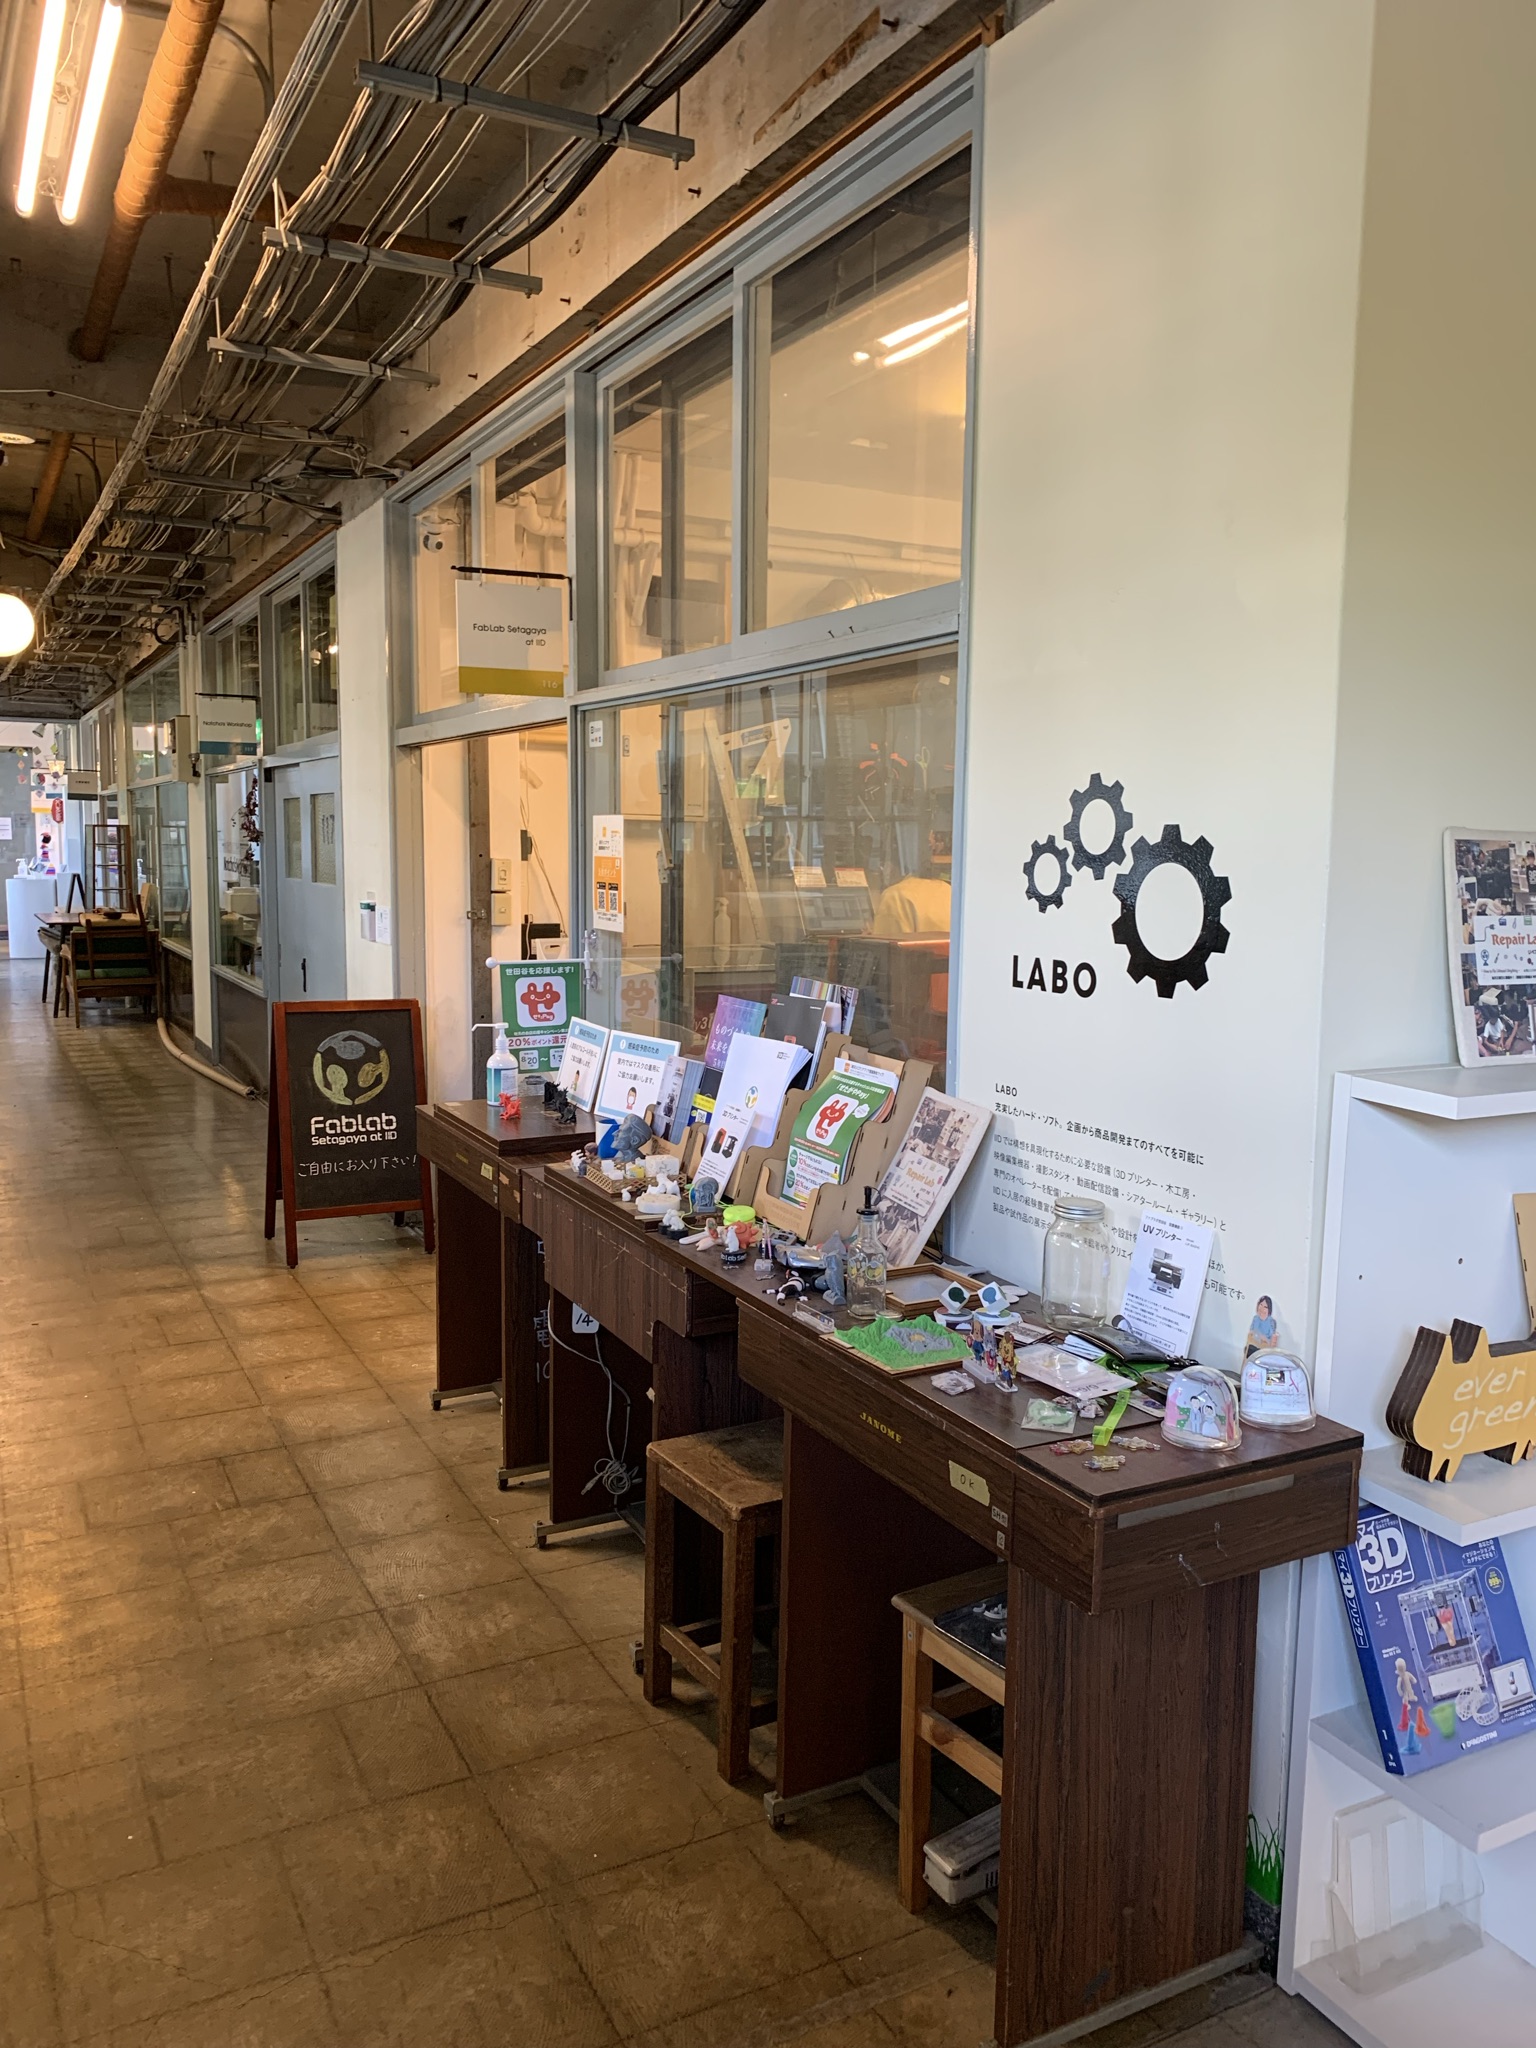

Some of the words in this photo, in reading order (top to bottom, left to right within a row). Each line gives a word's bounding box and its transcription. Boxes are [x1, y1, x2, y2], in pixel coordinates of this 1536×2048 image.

[473, 624, 505, 633] FabLab
[507, 625, 547, 635] Setagaya
[1491, 932, 1525, 949] Repair
[505, 966, 574, 976] 世田谷を応援します!
[1012, 954, 1097, 998] LABO
[995, 1083, 1018, 1097] LABO
[311, 1134, 367, 1146] Setagaya
[370, 1133, 382, 1141] at
[298, 1154, 417, 1177] ご自由にお入り下さい!
[1454, 1366, 1526, 1402] ever
[859, 1412, 902, 1444] JANOME
[1358, 1527, 1408, 1574] 3D
[1368, 1569, 1412, 1591] プリンター
